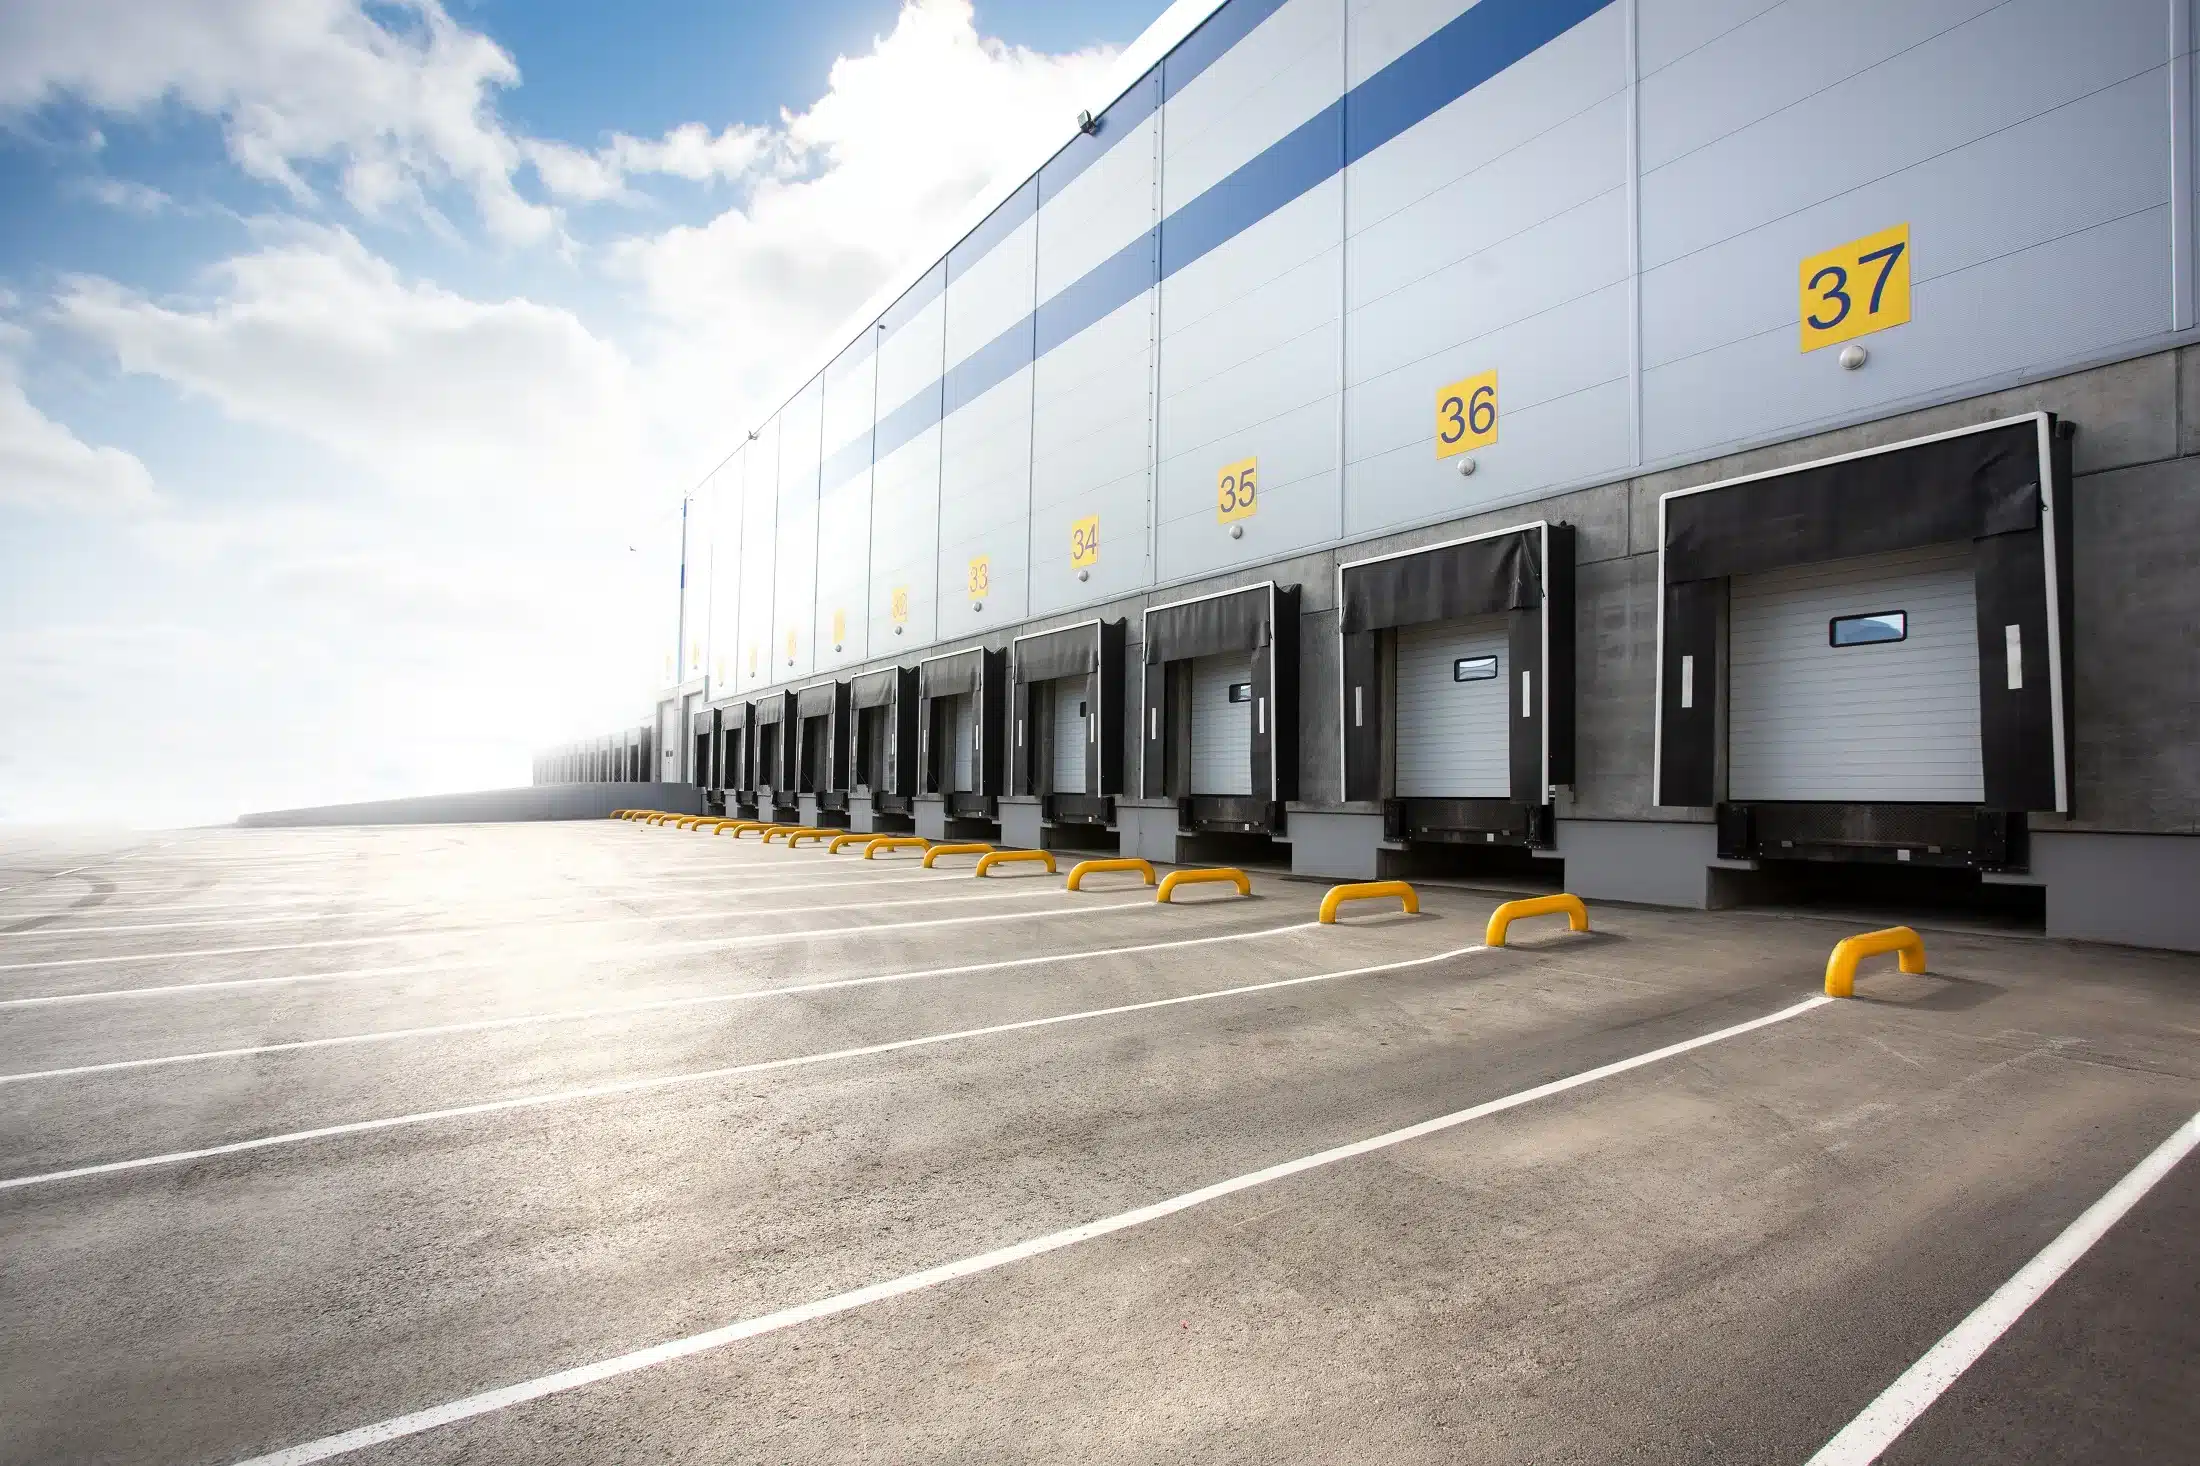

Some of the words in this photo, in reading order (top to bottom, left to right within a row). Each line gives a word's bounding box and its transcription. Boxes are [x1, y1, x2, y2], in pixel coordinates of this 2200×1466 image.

[1807, 242, 1905, 330] 37
[1441, 386, 1495, 443] 36
[1221, 468, 1255, 513] 35
[1073, 523, 1096, 560] 34
[970, 564, 988, 592] 33
